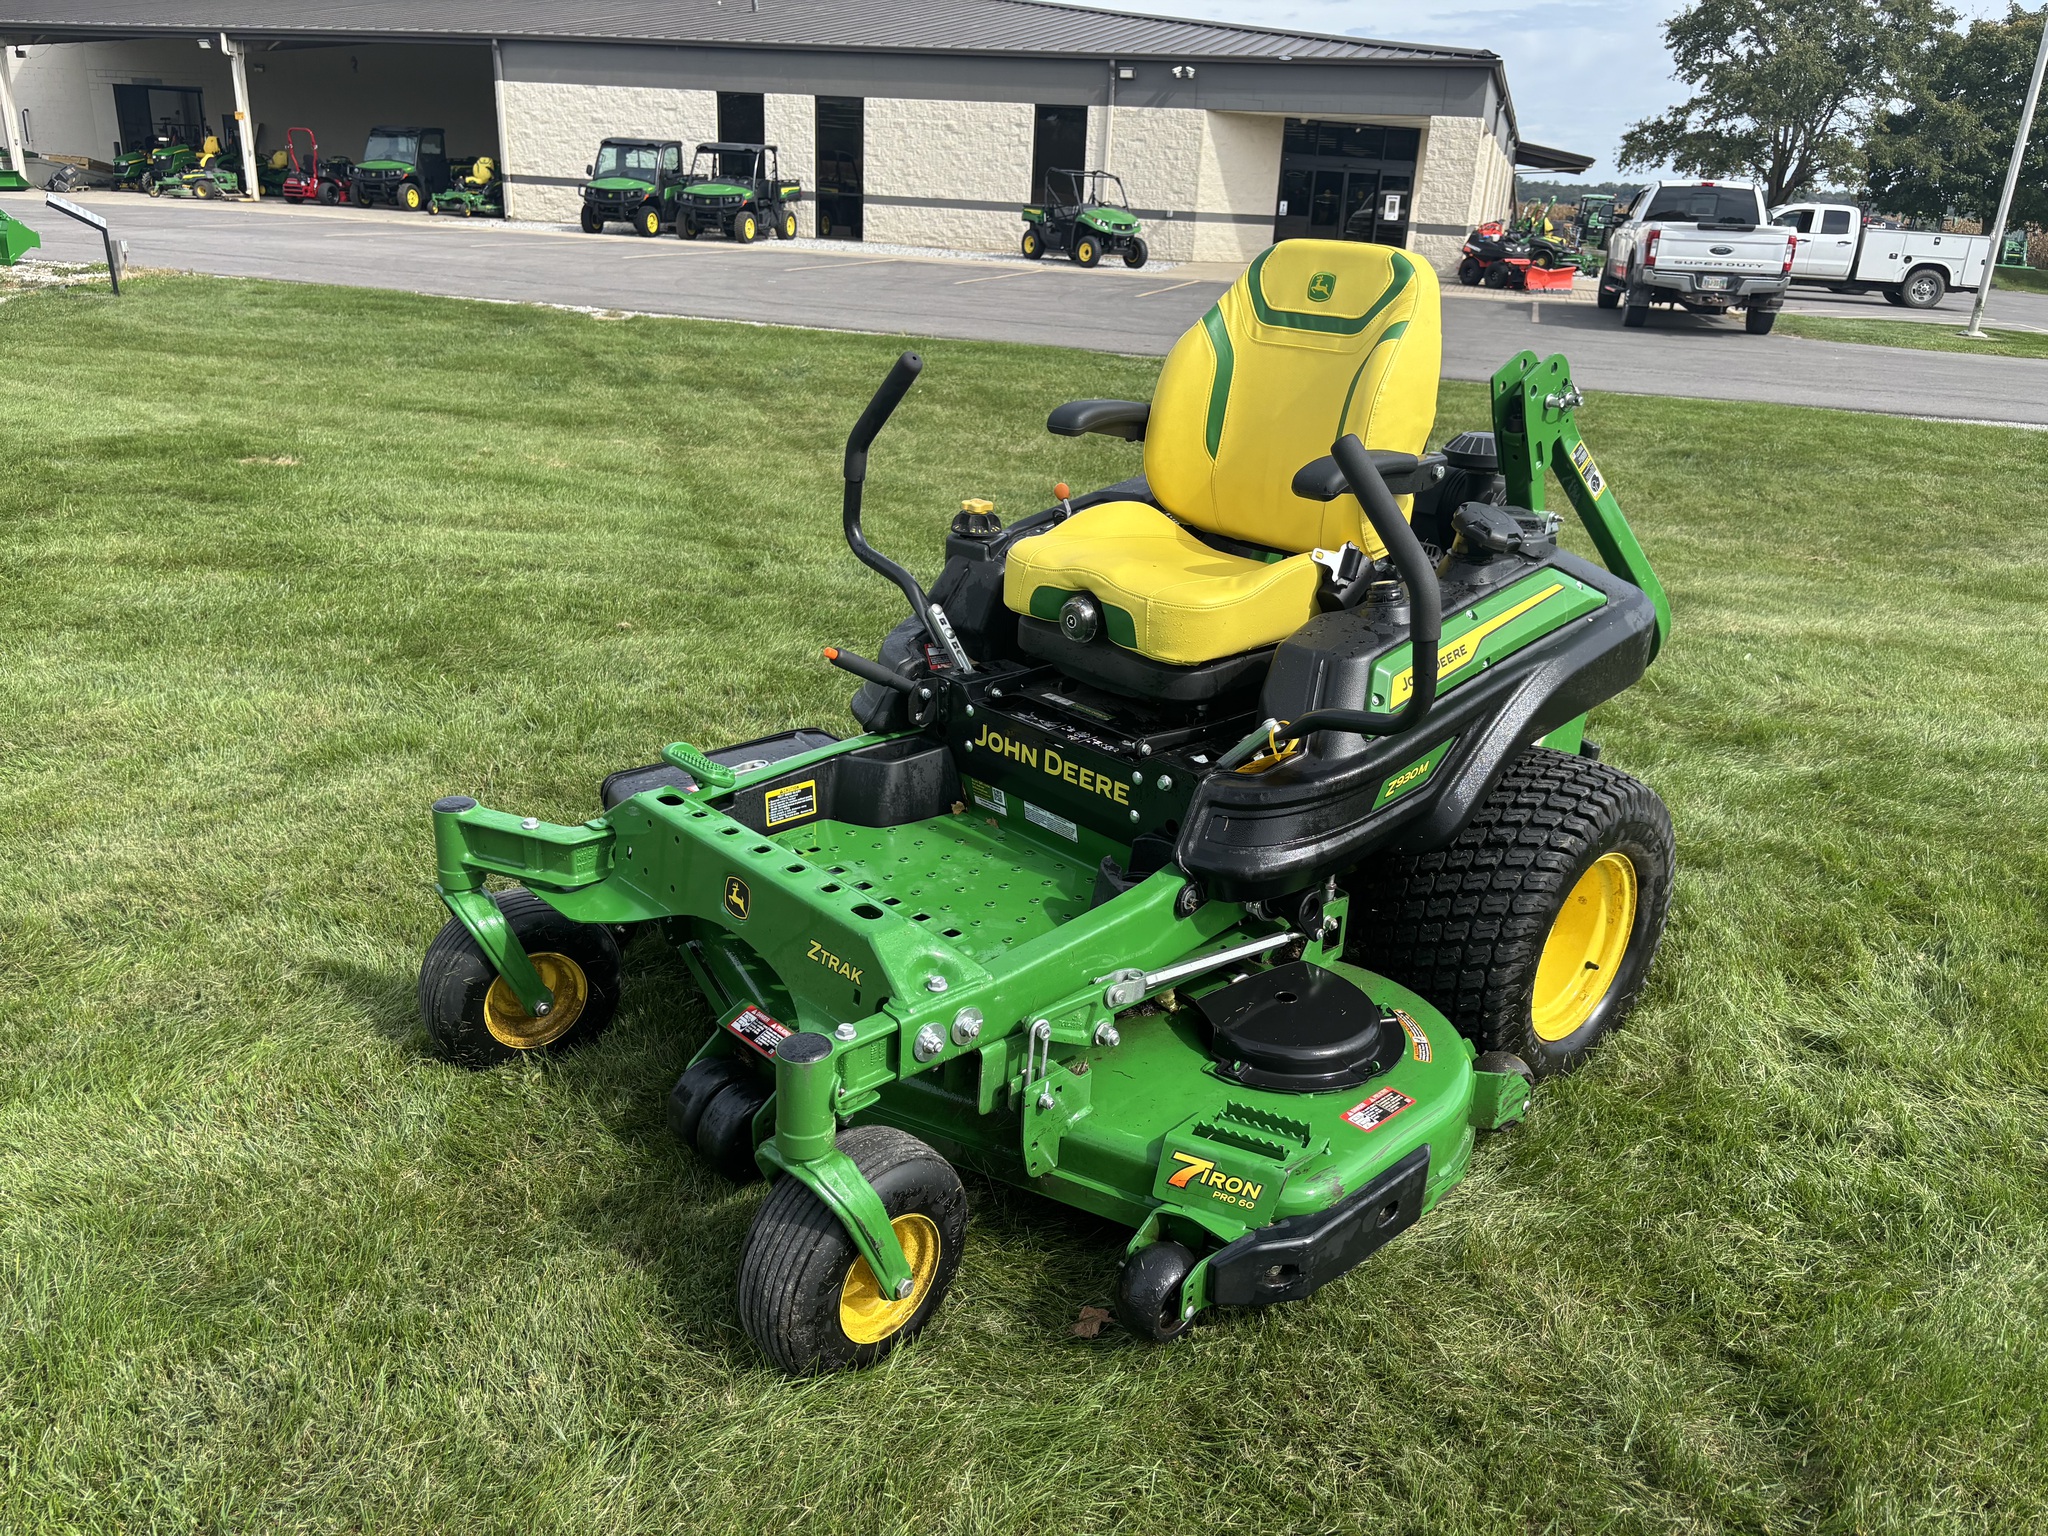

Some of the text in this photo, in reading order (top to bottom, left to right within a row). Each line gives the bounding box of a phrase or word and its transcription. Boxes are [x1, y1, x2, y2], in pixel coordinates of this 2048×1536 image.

[974, 723, 1037, 768] JOHN
[1044, 748, 1130, 806] DEERE
[1384, 760, 1430, 798] Z930M
[806, 939, 864, 986] ZTRAK
[1167, 1150, 1263, 1201] 7 IRON
[1212, 1191, 1255, 1210] PRO 60
